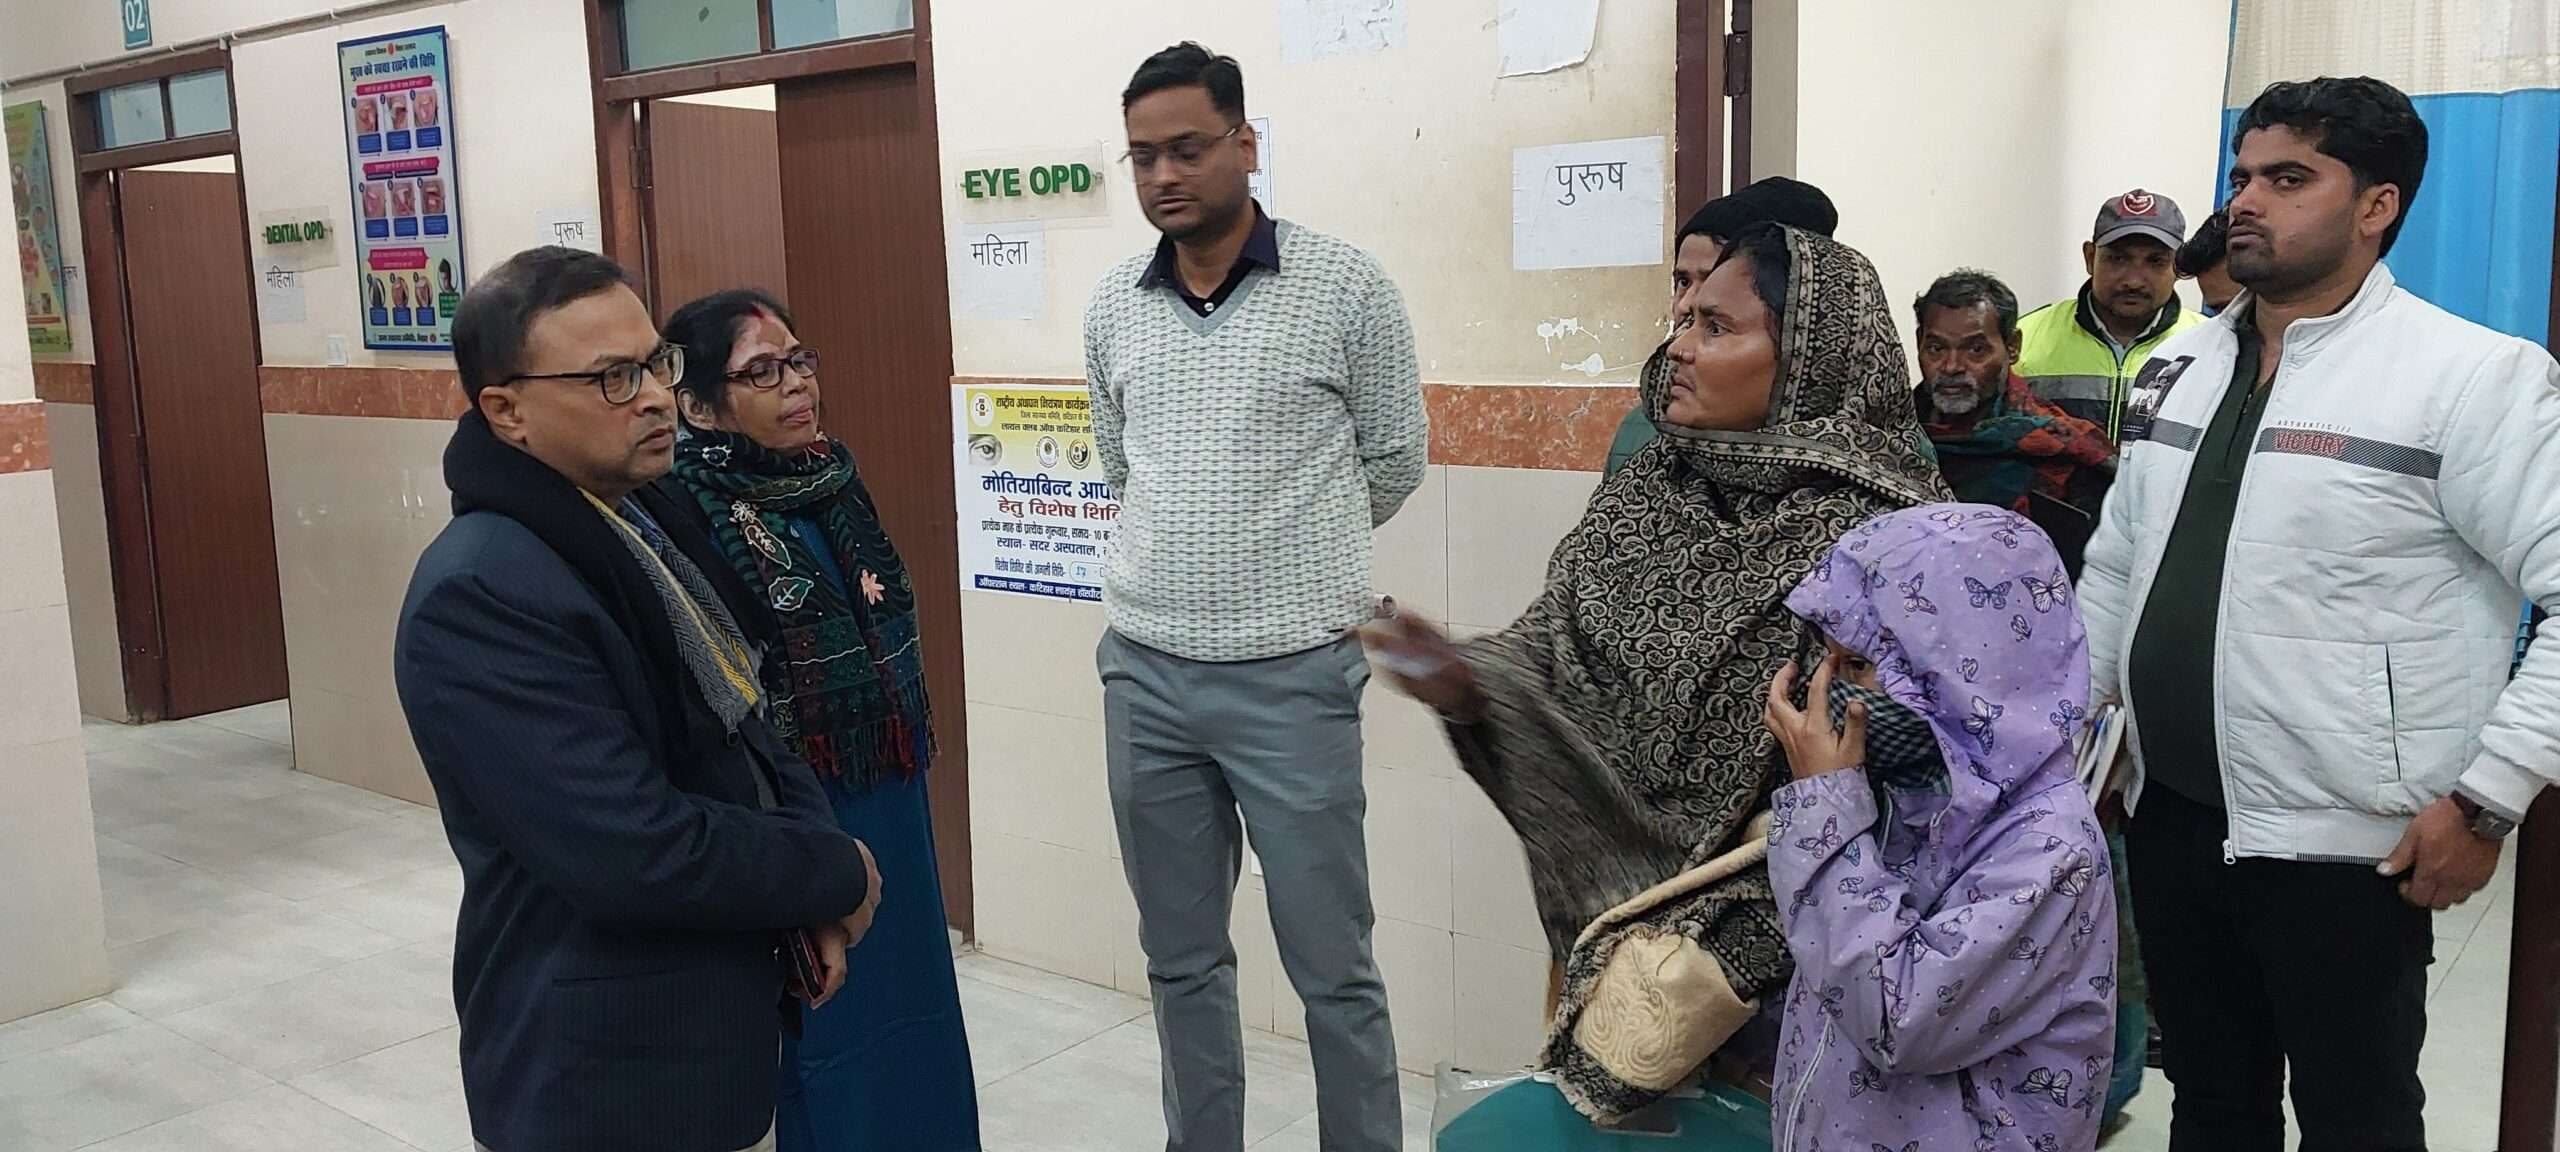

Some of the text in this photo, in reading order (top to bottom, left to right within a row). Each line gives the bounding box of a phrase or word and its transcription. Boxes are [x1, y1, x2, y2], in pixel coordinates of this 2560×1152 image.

[125, 0, 145, 31] 02
[964, 163, 1091, 198] EYE OPD
[266, 221, 325, 245] DENTAL OPD
[970, 233, 1029, 266] महिला
[265, 265, 295, 289] महिला
[2277, 420, 2333, 430] AUTHENTIC
[2276, 431, 2347, 454] VICTORY
[981, 470, 1119, 501] मोतियाबिन्द आप
[997, 496, 1024, 518] हेतु
[1028, 498, 1077, 518] विशेष
[1029, 540, 1051, 552] सदर
